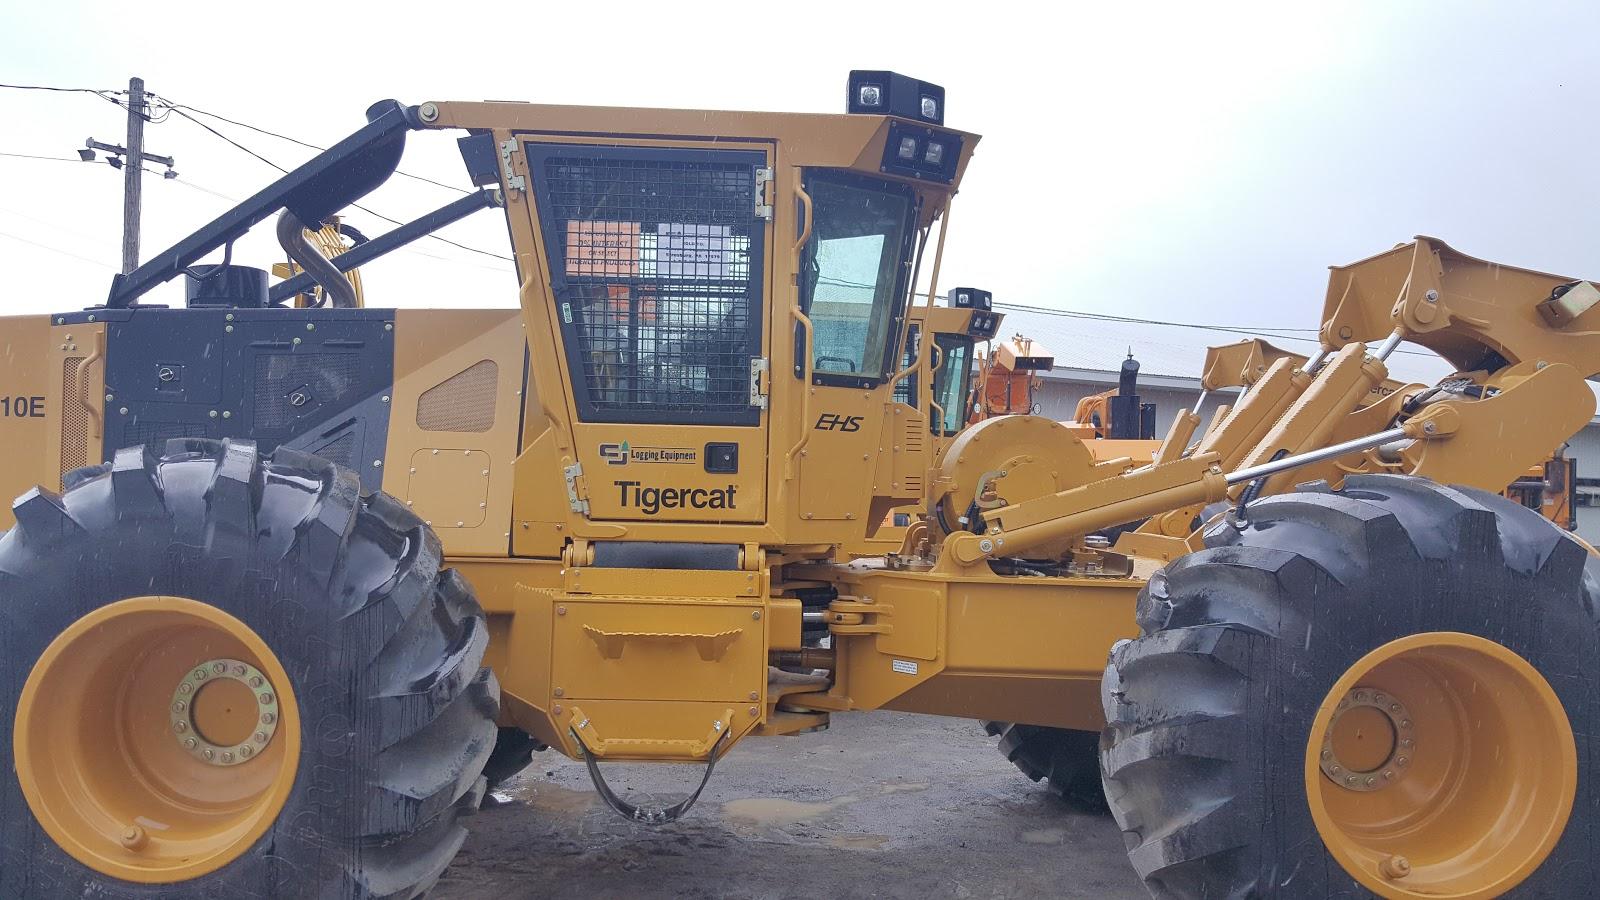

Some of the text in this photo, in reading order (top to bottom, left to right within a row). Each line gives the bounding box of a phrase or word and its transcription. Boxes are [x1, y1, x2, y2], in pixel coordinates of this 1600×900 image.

[0, 396, 46, 417] 10E
[814, 413, 865, 432] EHS
[631, 449, 659, 461] Logging
[660, 451, 696, 462] Equipment
[613, 480, 737, 515] Tigercat
